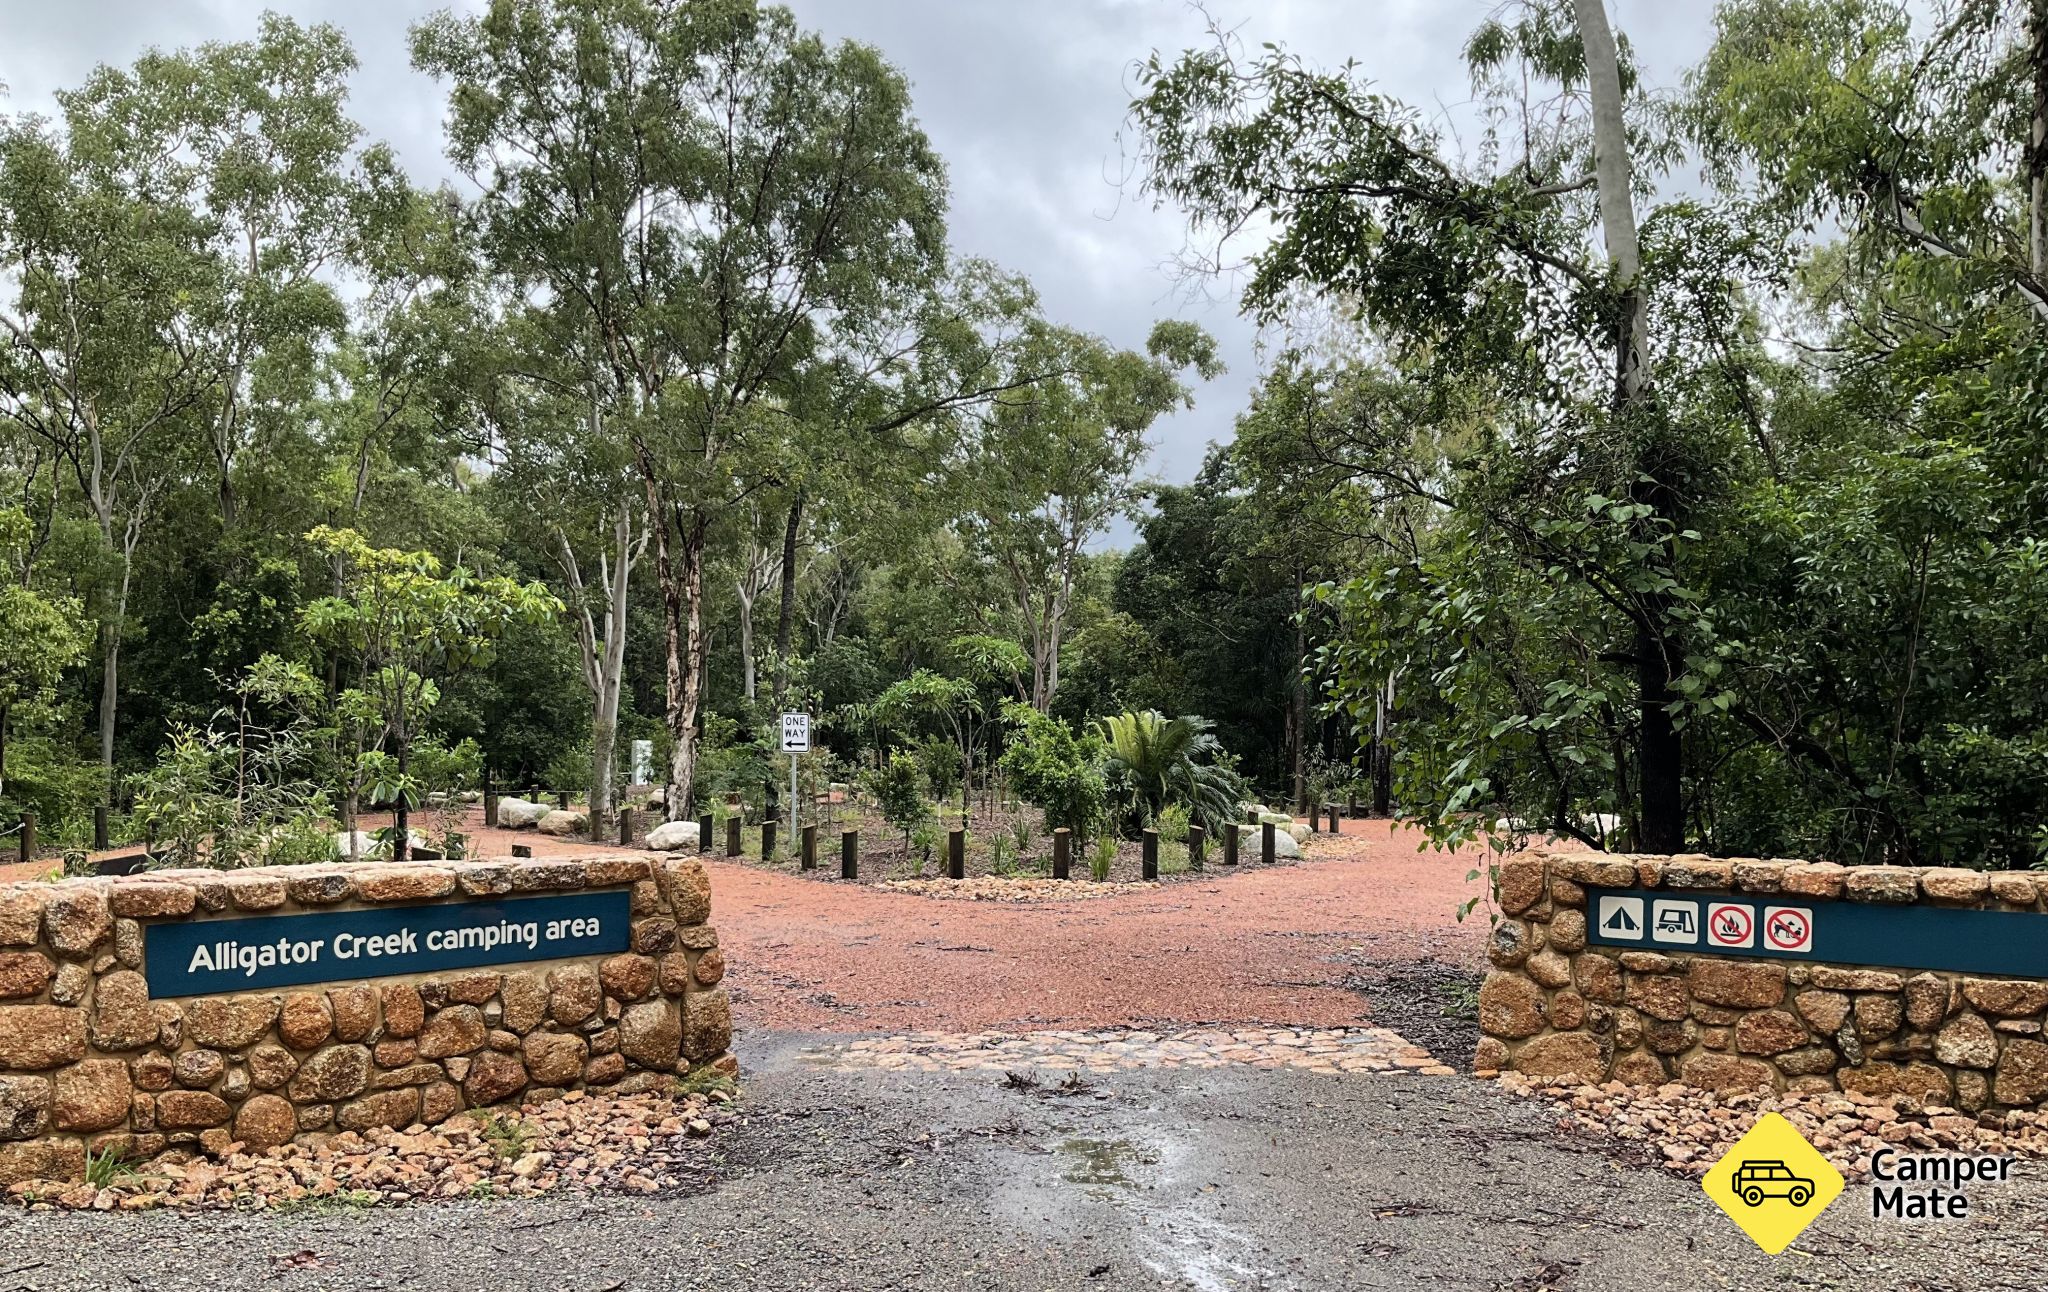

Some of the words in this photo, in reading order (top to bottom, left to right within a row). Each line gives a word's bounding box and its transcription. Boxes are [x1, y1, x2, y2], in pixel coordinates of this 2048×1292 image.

[785, 716, 805, 726] ONE
[785, 728, 806, 738] WAY
[188, 938, 324, 976] Alligator
[333, 928, 418, 959] Creek
[426, 919, 539, 951] camping
[544, 913, 601, 940] area
